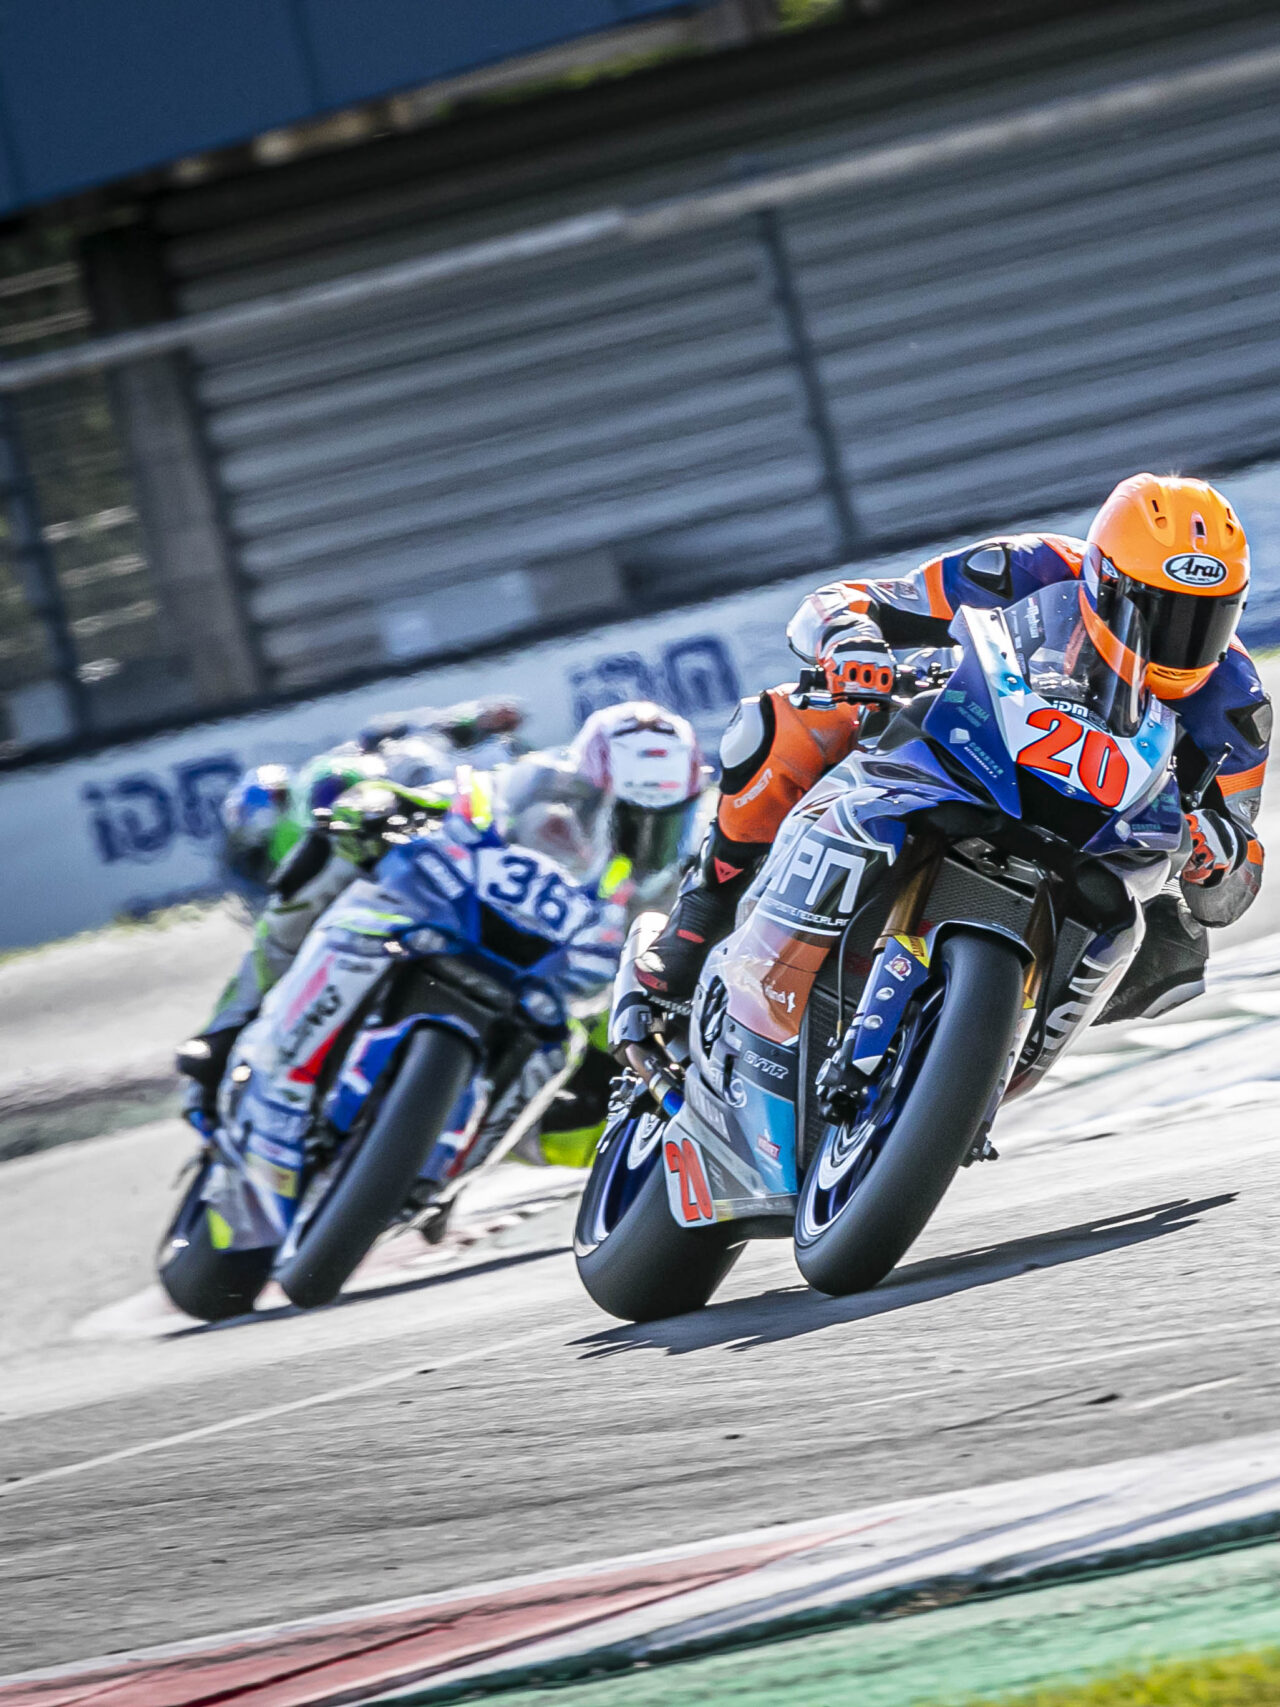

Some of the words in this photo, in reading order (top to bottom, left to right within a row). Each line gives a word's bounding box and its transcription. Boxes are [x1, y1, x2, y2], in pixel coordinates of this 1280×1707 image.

[1173, 557, 1222, 578] Arai
[1016, 707, 1130, 808] 20
[488, 855, 567, 931] 36
[664, 1137, 713, 1222] 20
